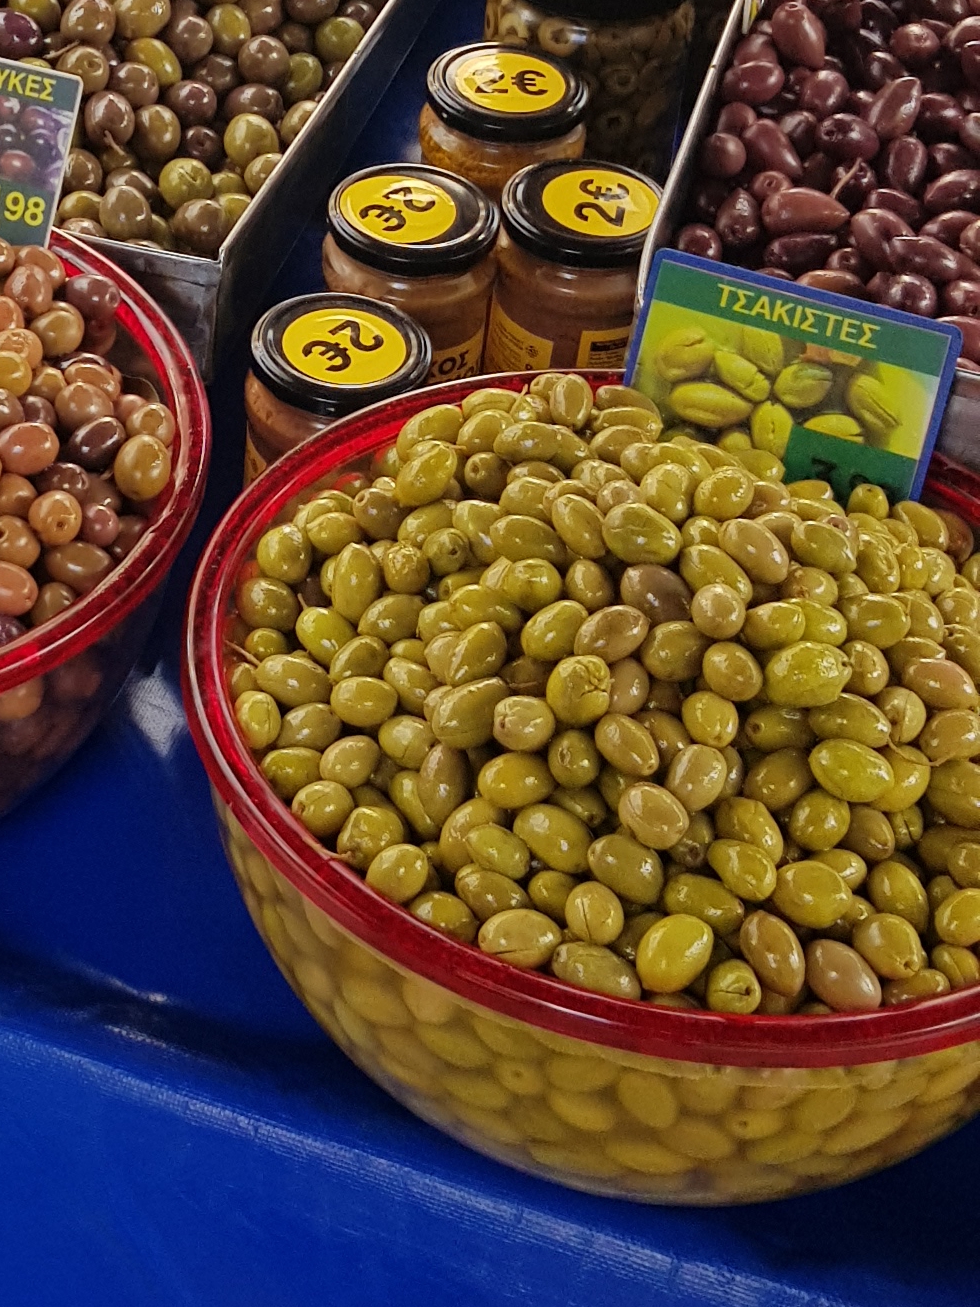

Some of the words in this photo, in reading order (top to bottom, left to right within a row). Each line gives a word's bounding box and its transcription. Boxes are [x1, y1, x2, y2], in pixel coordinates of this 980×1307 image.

[473, 67, 549, 97] 2€
[359, 186, 436, 232] 2€
[573, 178, 630, 228] 2€
[718, 282, 881, 349] ΤΣΑΚΙΣΤΕΣ
[302, 319, 385, 372] 2€
